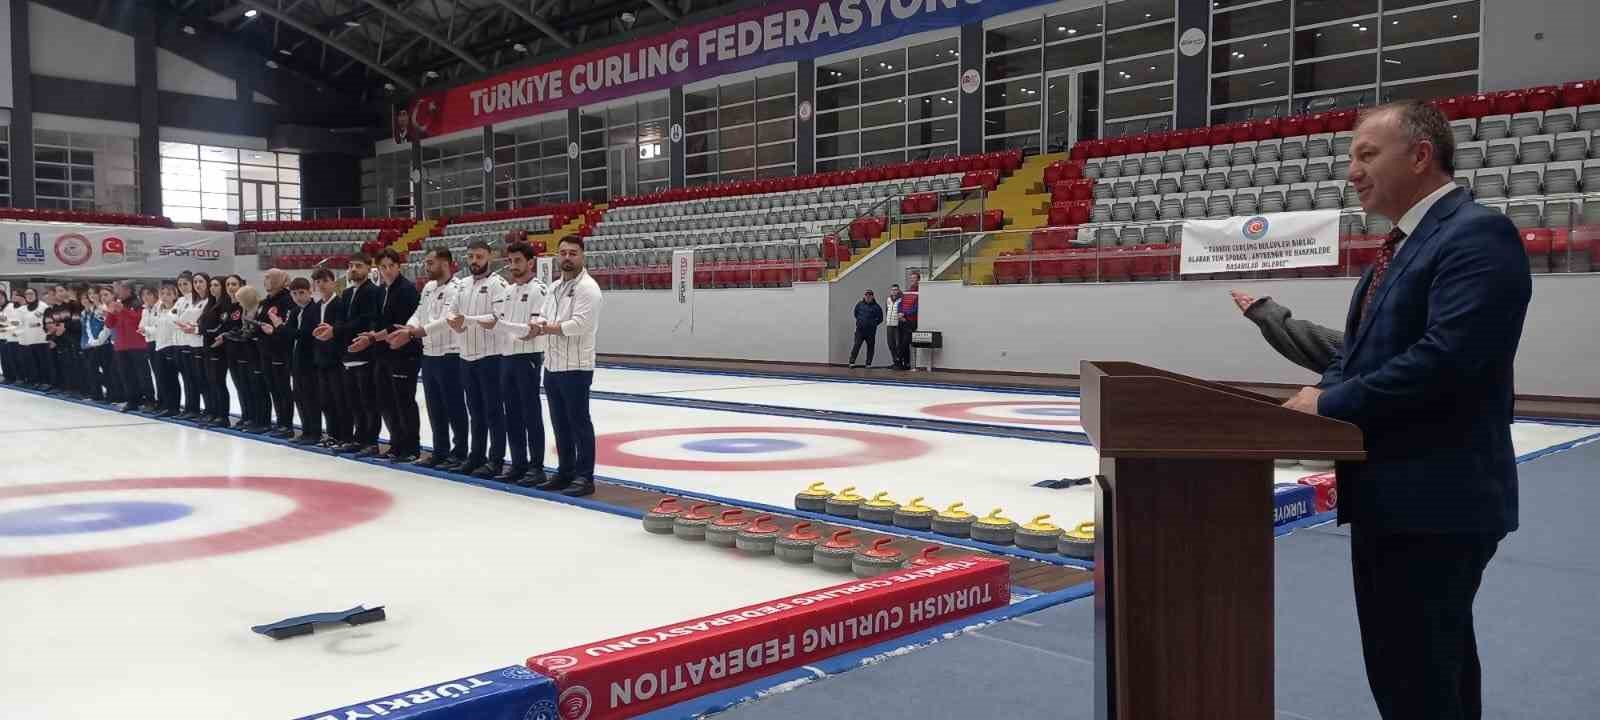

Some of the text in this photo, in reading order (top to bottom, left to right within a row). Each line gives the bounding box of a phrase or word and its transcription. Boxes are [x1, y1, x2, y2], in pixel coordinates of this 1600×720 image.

[470, 0, 981, 116] TÜRKİYE CURLING FEDERASY
[585, 601, 793, 658] FEDERASYONU
[793, 579, 892, 607] CURLING
[610, 582, 992, 708] TURKISH CURLING FEDERATION
